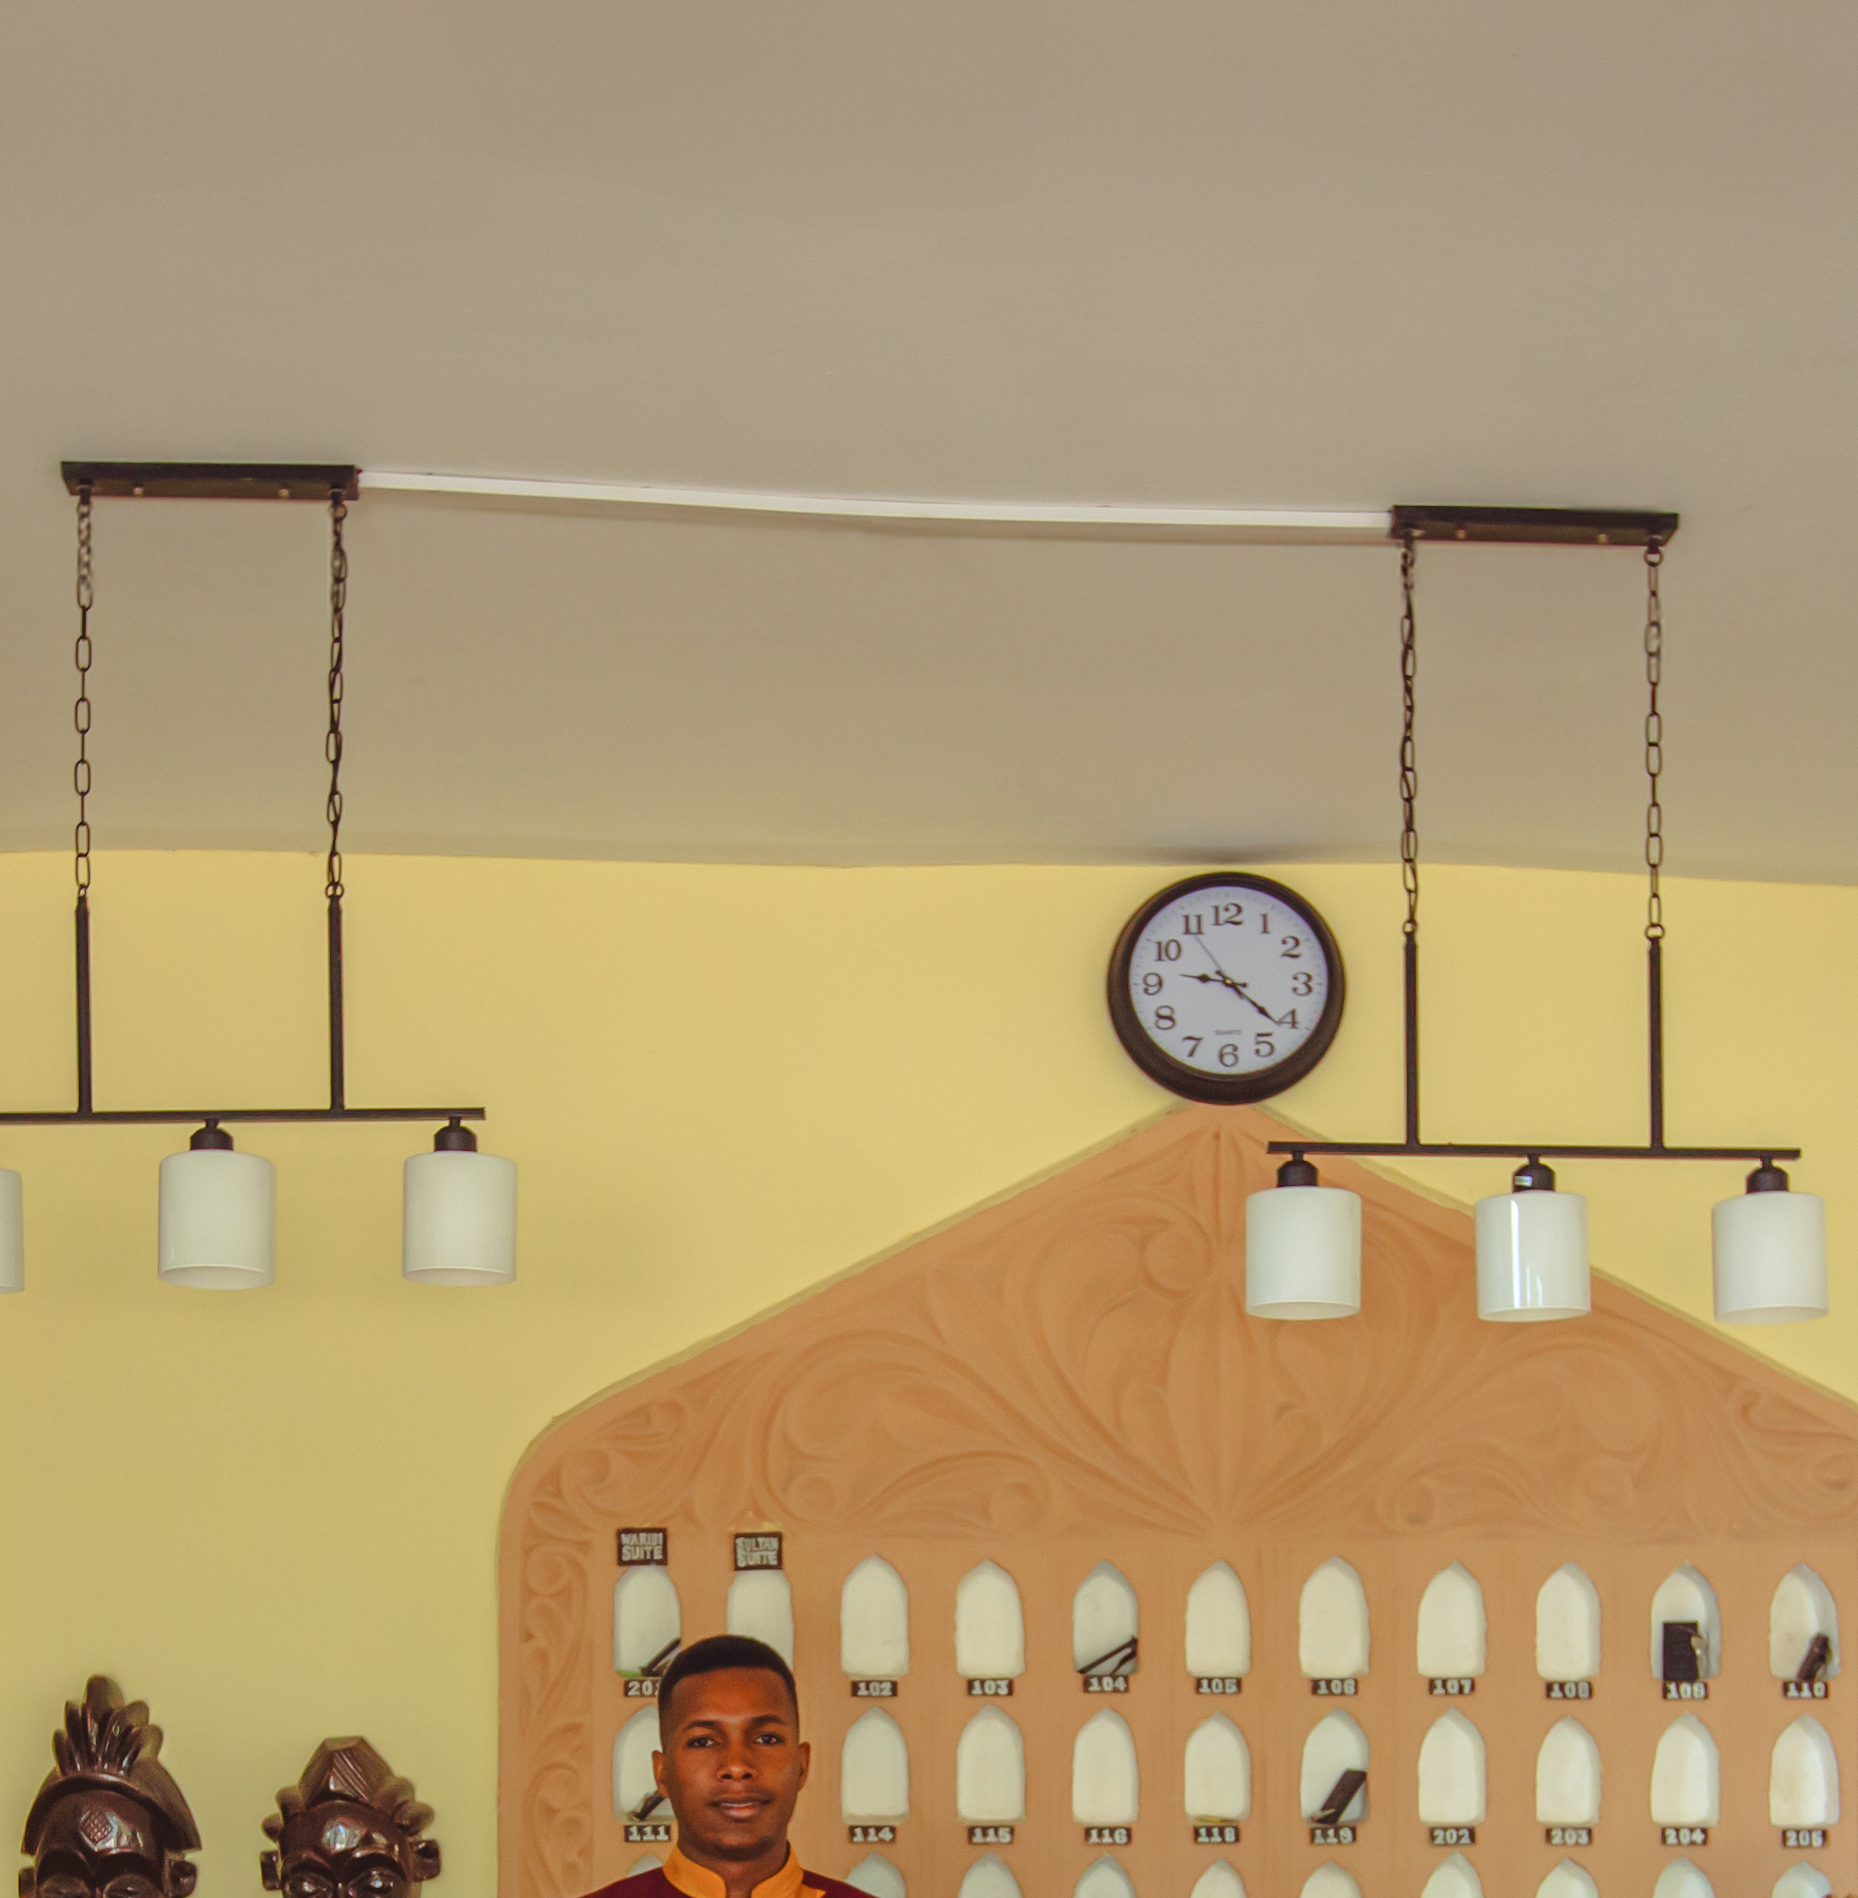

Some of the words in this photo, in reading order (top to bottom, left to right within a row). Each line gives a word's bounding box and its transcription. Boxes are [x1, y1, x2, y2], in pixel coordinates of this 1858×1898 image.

[1211, 903, 1243, 926] 12
[1182, 914, 1205, 935] 11
[1260, 914, 1271, 934] 1
[1154, 939, 1181, 961] 10
[1280, 936, 1302, 959] 2
[1143, 972, 1163, 996] 9
[1292, 972, 1314, 996] 3
[1154, 1005, 1176, 1030] 8
[1277, 1009, 1299, 1029] 4
[1182, 1036, 1204, 1058] 7
[1254, 1032, 1275, 1058] 5
[1218, 1044, 1238, 1067] 6
[620, 1532, 664, 1546] WARIDI
[735, 1537, 779, 1551] SULTAN
[621, 1546, 663, 1561] SUITE
[628, 1680, 657, 1695] 20
[856, 1681, 893, 1696] 102
[972, 1680, 1008, 1695] 103
[1089, 1677, 1126, 1691] 104
[1200, 1678, 1237, 1694] 105
[1318, 1679, 1356, 1694] 106
[1433, 1678, 1472, 1694] 107
[1788, 1682, 1825, 1699] 110
[629, 1826, 668, 1840] 111
[854, 1827, 892, 1842] 114
[973, 1828, 1011, 1843] 115
[1089, 1829, 1127, 1844] 116
[1435, 1829, 1470, 1844] 202
[1553, 1828, 1588, 1845] 203
[1667, 1828, 1704, 1844] 204
[1788, 1831, 1822, 1847] 205
